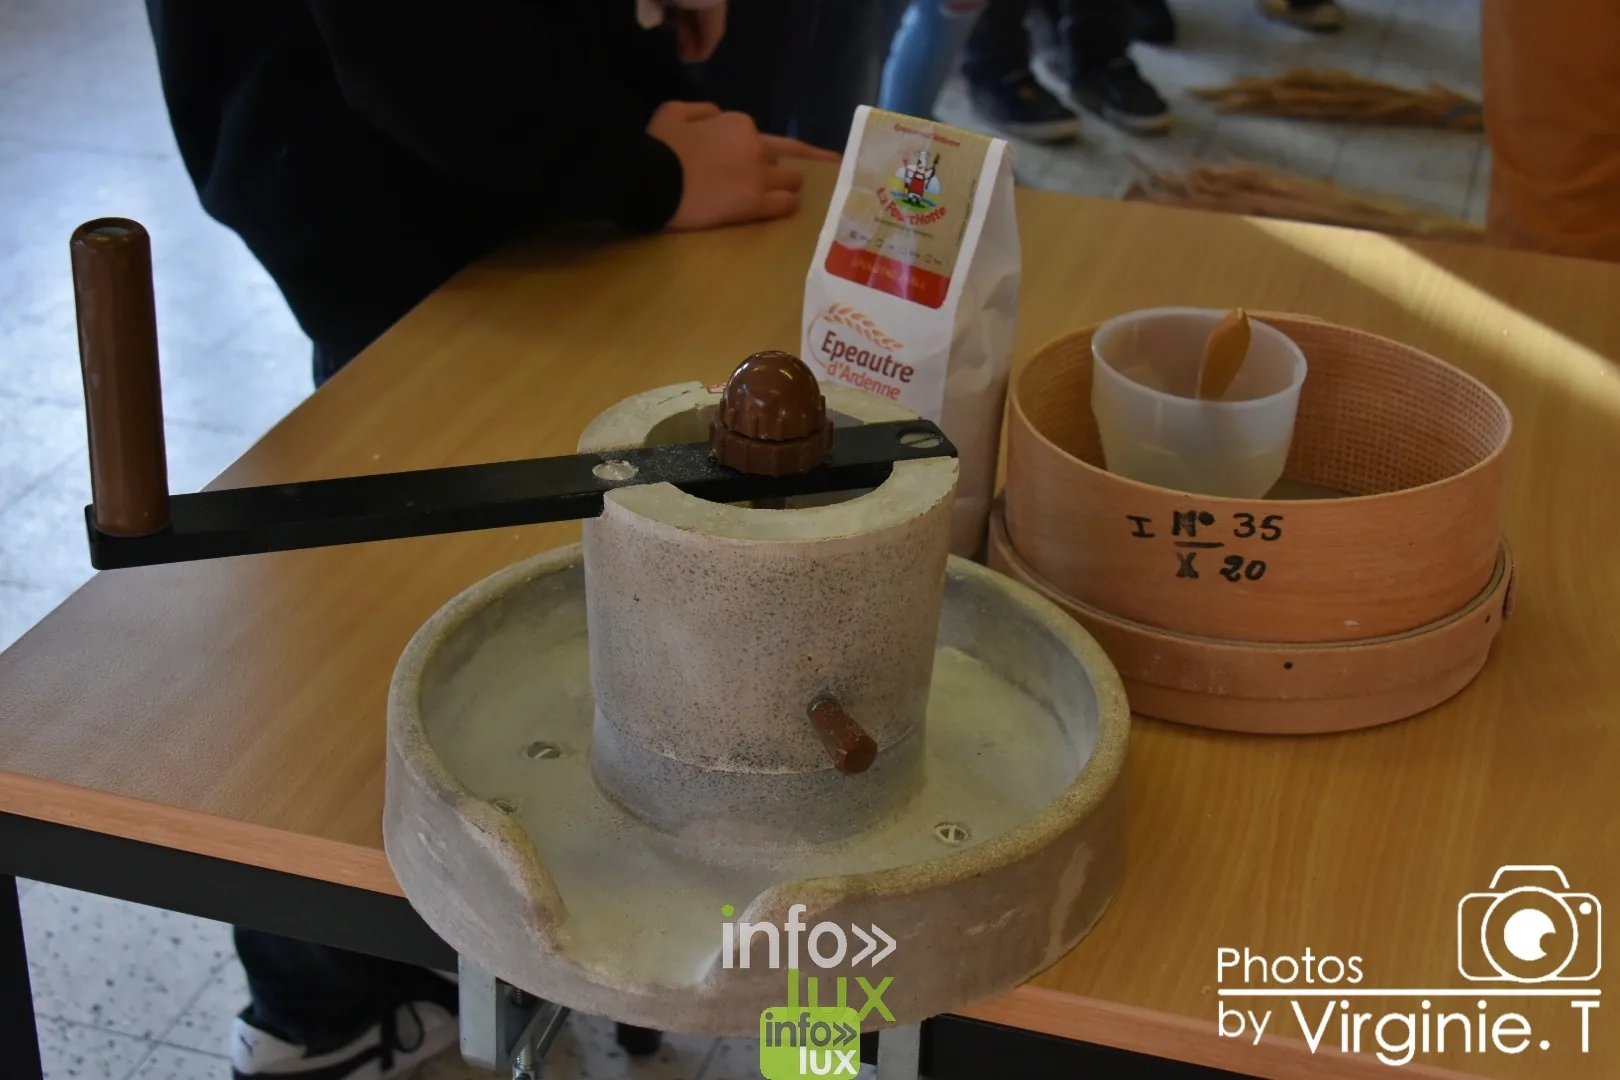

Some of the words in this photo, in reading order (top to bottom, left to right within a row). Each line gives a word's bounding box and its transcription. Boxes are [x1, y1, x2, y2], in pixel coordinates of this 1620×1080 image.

[821, 330, 915, 383] Epeautre
[826, 362, 901, 401] d'Ardenne
[1233, 512, 1284, 541] 35
[1219, 554, 1267, 582] 20
